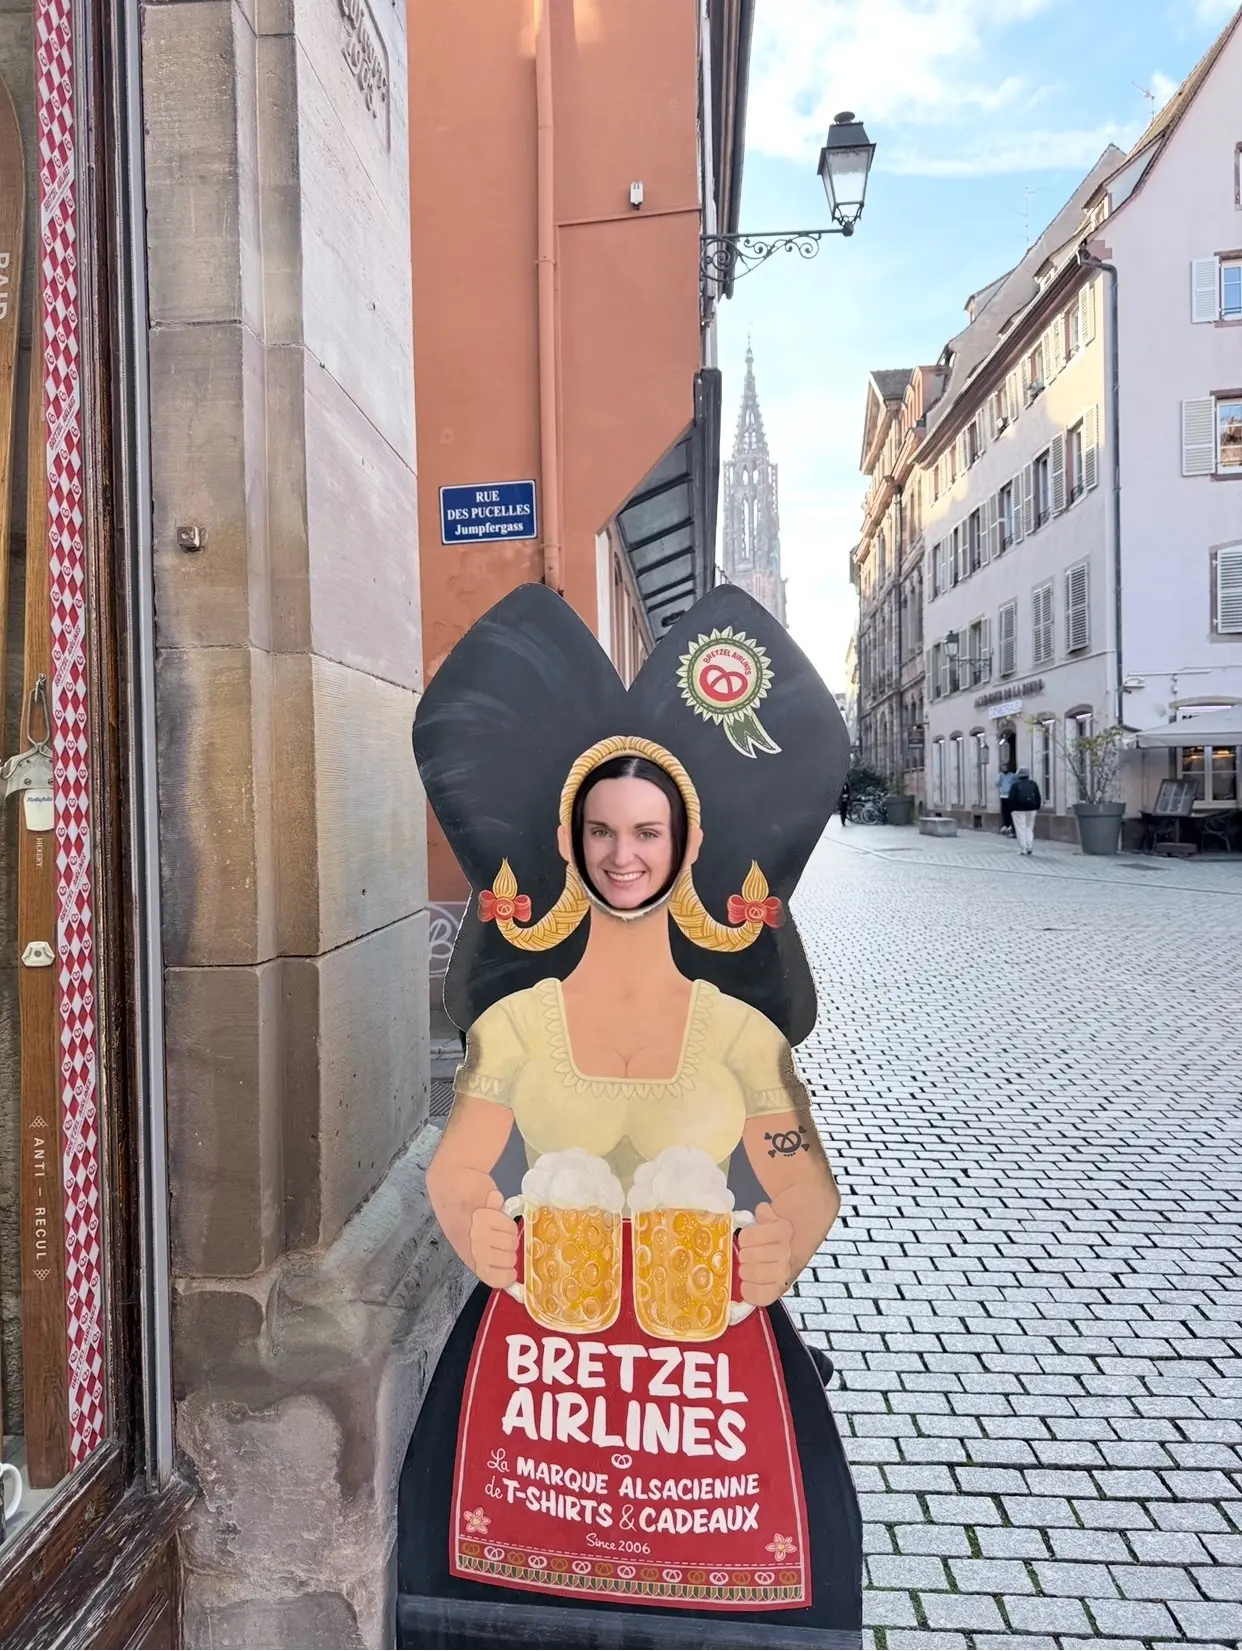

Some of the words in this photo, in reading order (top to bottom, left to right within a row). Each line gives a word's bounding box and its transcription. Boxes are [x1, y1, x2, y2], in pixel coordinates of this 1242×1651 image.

[447, 508, 469, 520] DES
[471, 504, 531, 519] PUCELLES
[476, 490, 500, 503] RUE
[455, 522, 524, 536] Jumpfergass
[702, 648, 731, 664] BRETZEL
[731, 651, 752, 676] AIRLINES
[33, 1137, 45, 1177] ANTI
[35, 1207, 47, 1260] RECUL
[505, 1334, 749, 1404] BRETZEL
[502, 1387, 747, 1461] AIRLINES
[487, 1447, 510, 1472] La
[516, 1456, 609, 1495] MARQUE
[618, 1473, 760, 1501] ALSACIENNE
[485, 1476, 503, 1499] de
[502, 1478, 613, 1528] T-SHIRTS
[619, 1504, 637, 1532] &
[638, 1502, 760, 1534] CADEAUX
[586, 1532, 617, 1551] Since
[618, 1539, 651, 1555] 2006
